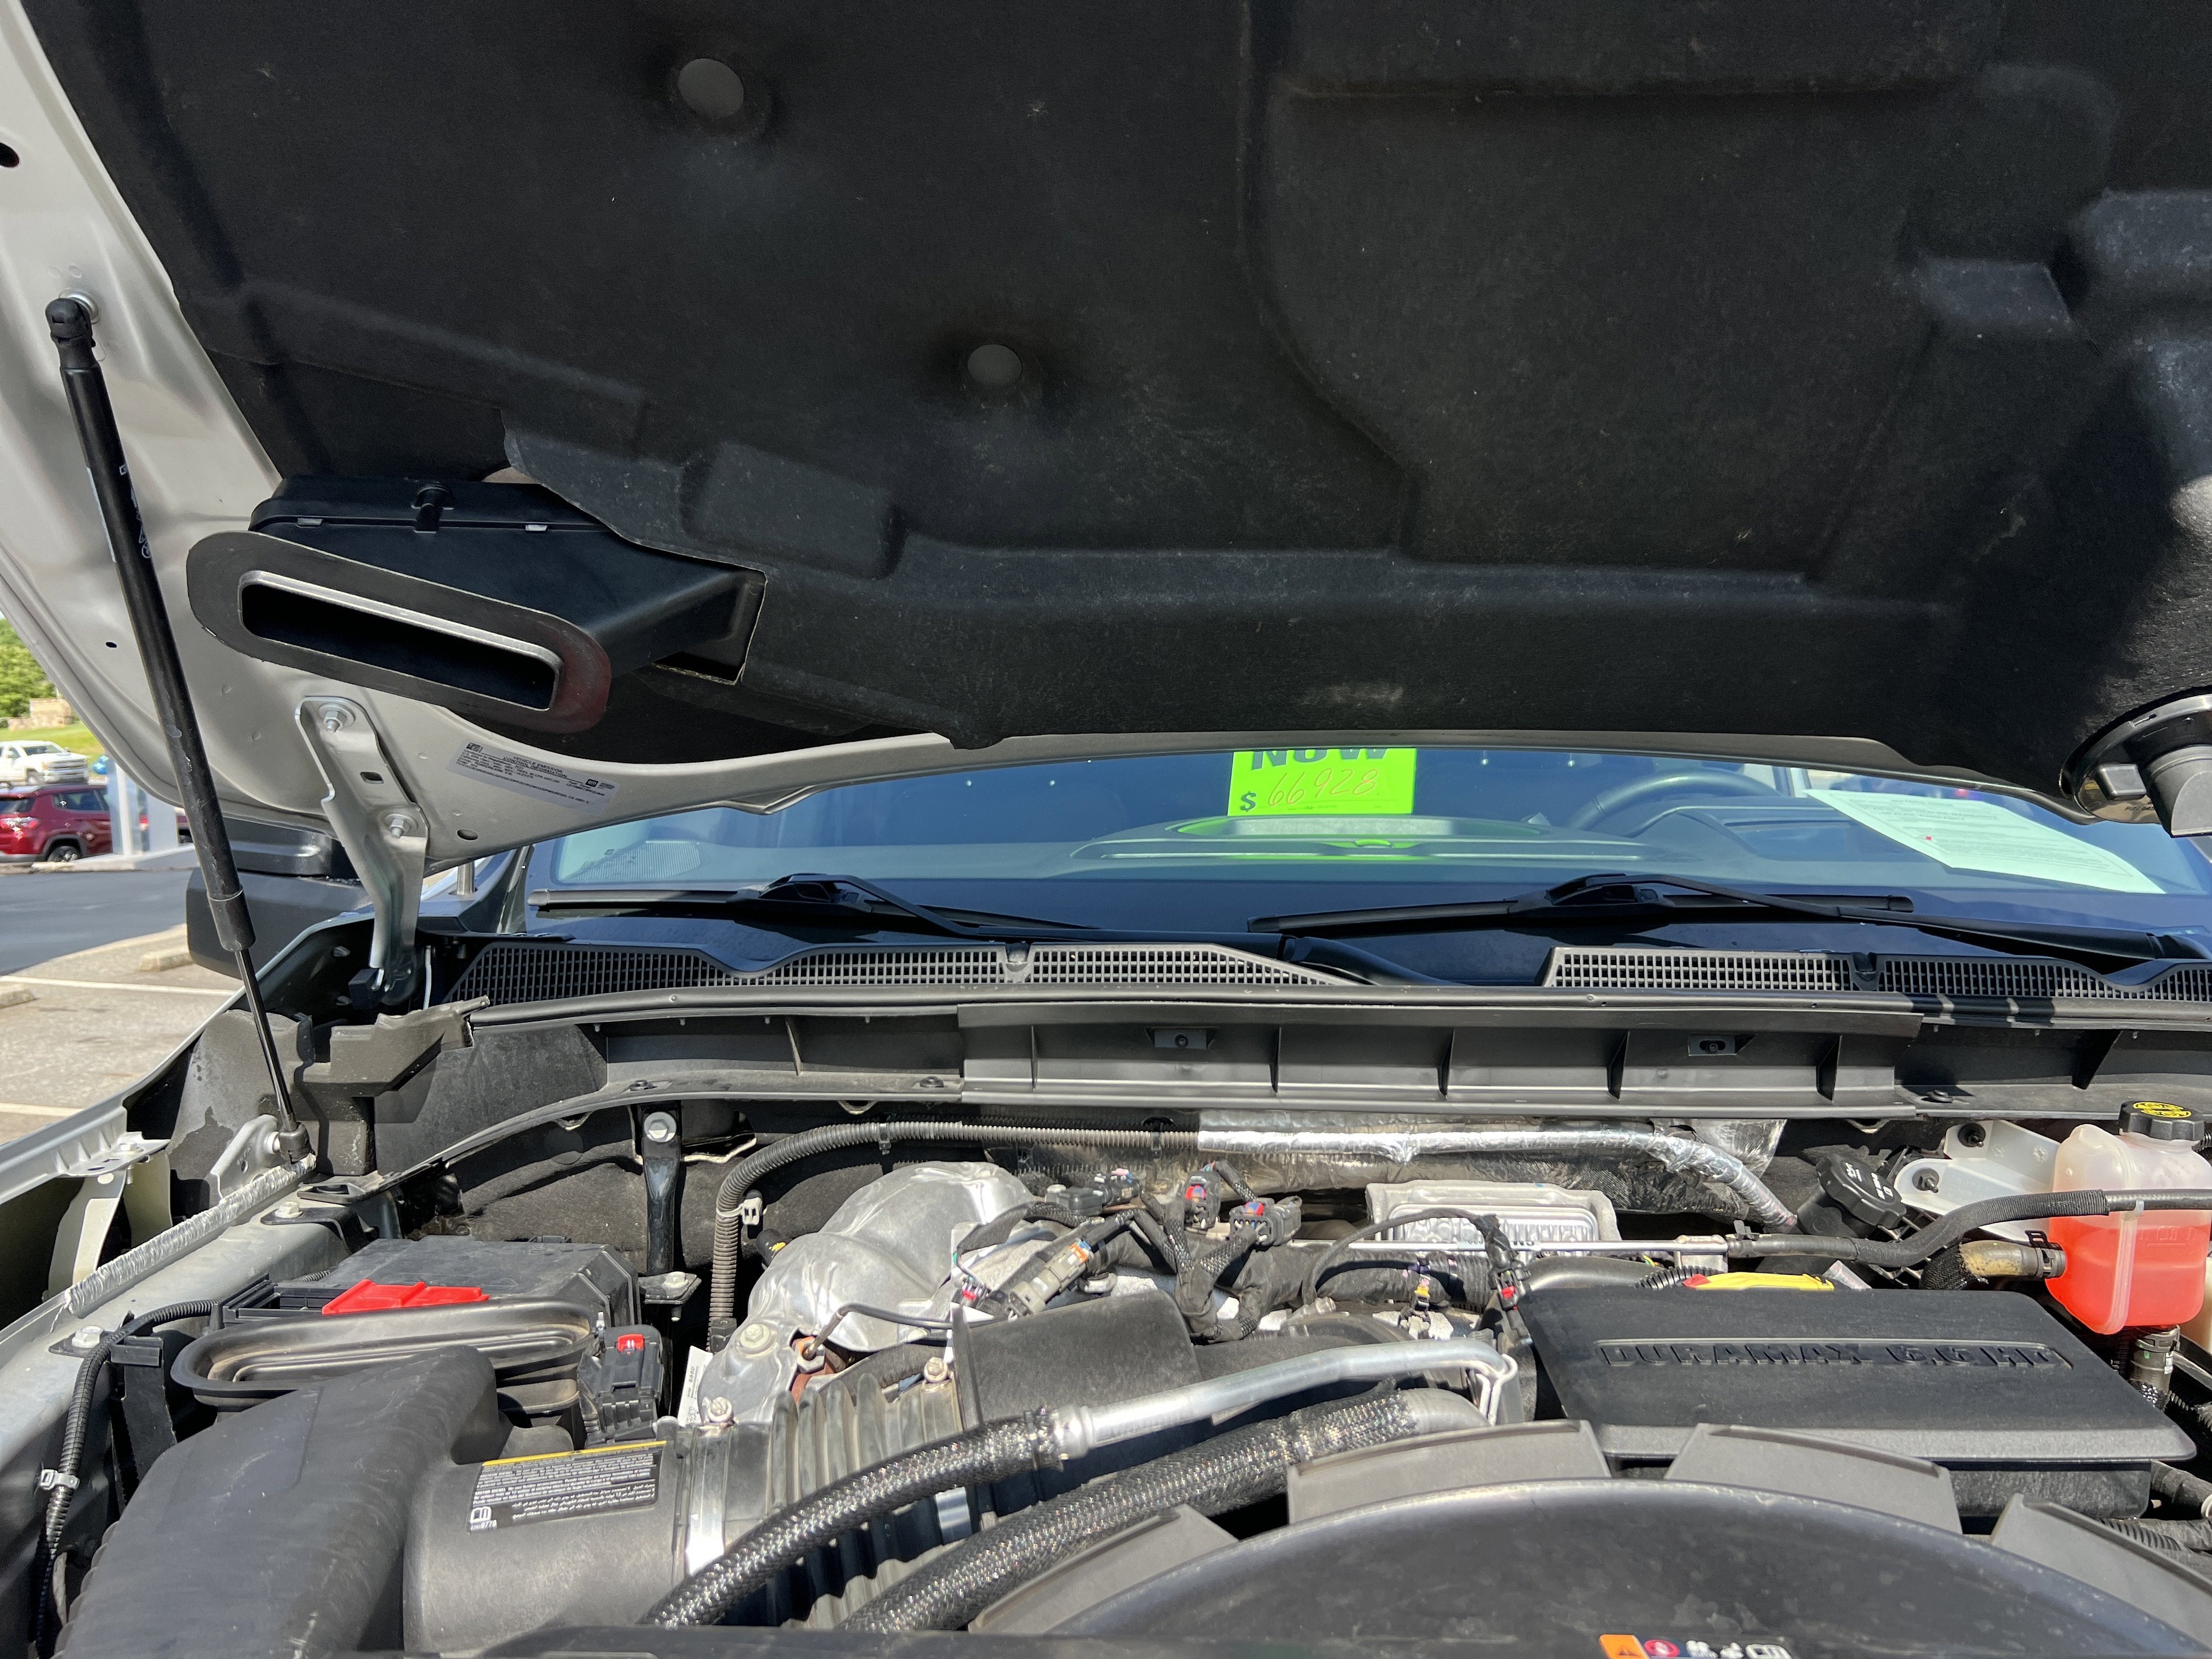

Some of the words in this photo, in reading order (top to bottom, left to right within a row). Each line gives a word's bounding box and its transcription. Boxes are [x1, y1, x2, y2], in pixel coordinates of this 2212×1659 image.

[1240, 791, 1256, 812] $
[1600, 1343, 1874, 1366] DURAMAX
[1885, 1345, 1976, 1365] 6.6
[1979, 1347, 2058, 1367] HD
